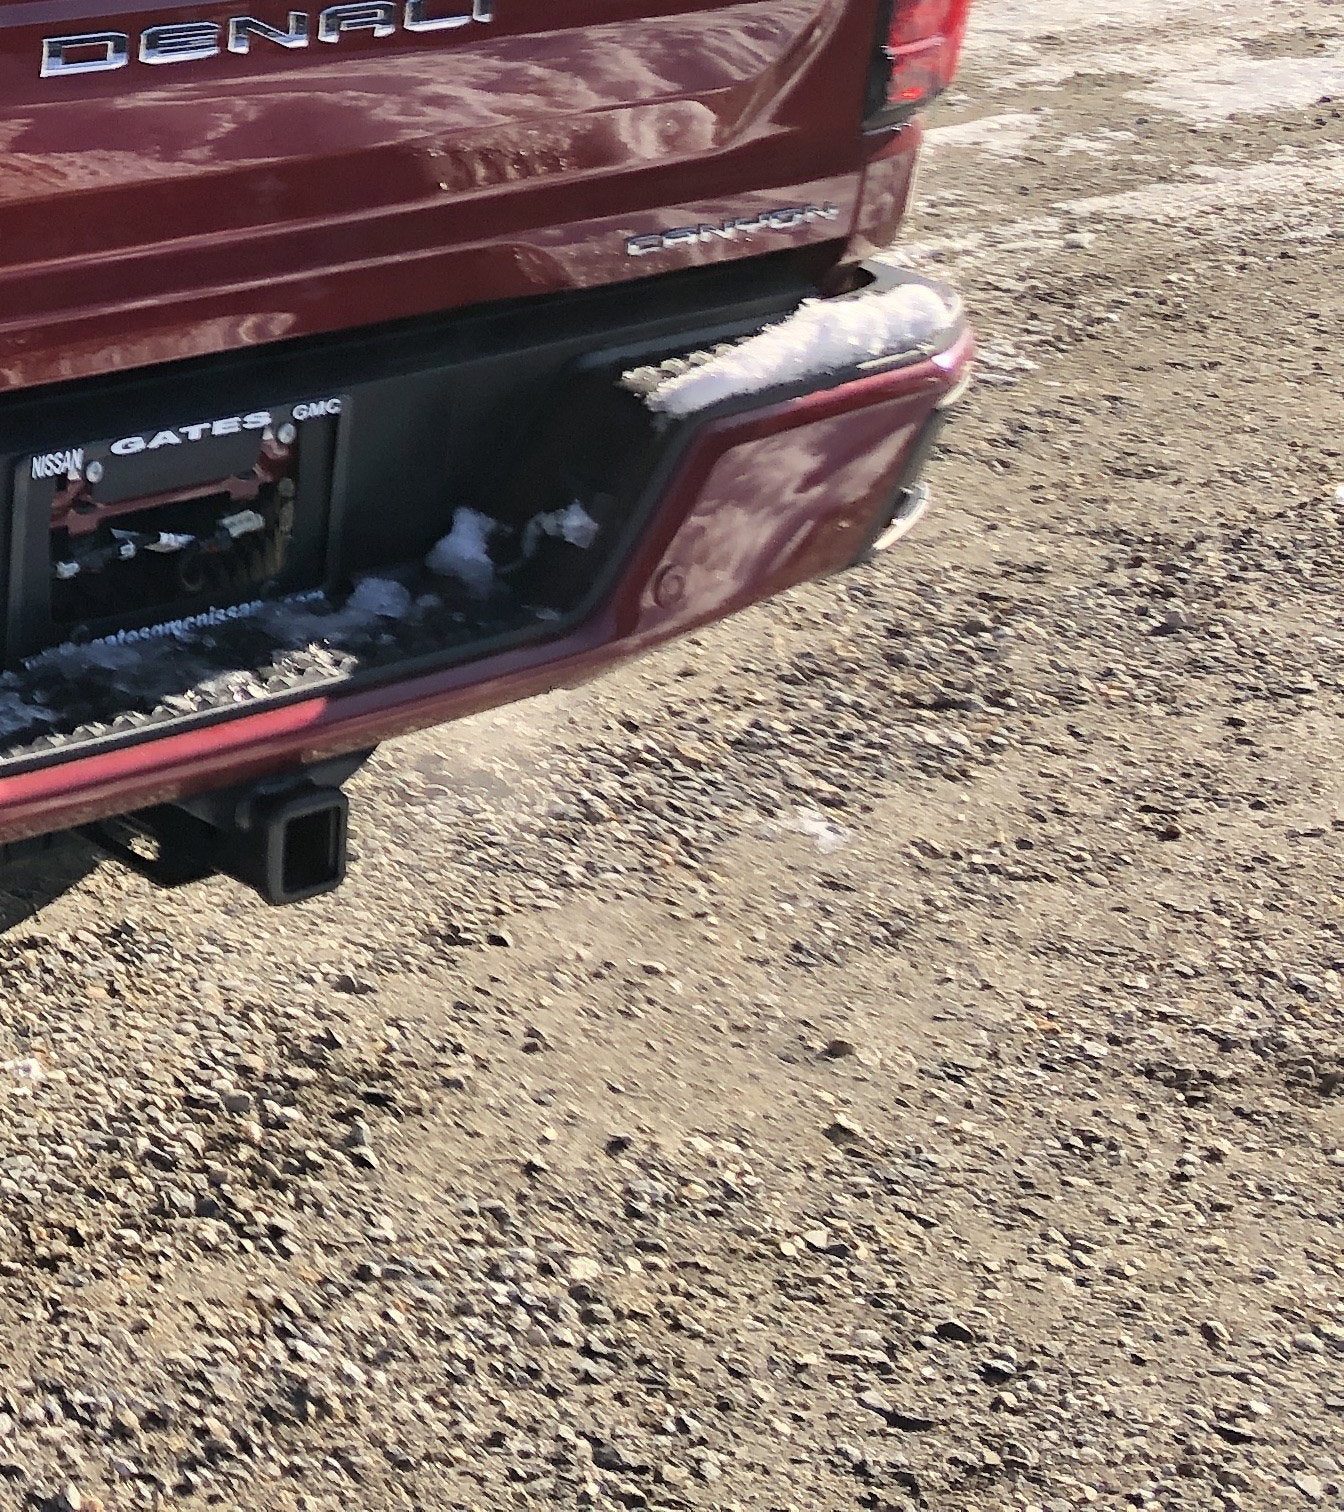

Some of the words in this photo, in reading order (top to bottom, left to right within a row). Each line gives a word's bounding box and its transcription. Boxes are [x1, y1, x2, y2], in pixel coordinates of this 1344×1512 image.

[626, 204, 840, 256] CANYON
[31, 448, 85, 480] NISSAN
[110, 411, 272, 455] GATES
[292, 398, 342, 421] GMC
